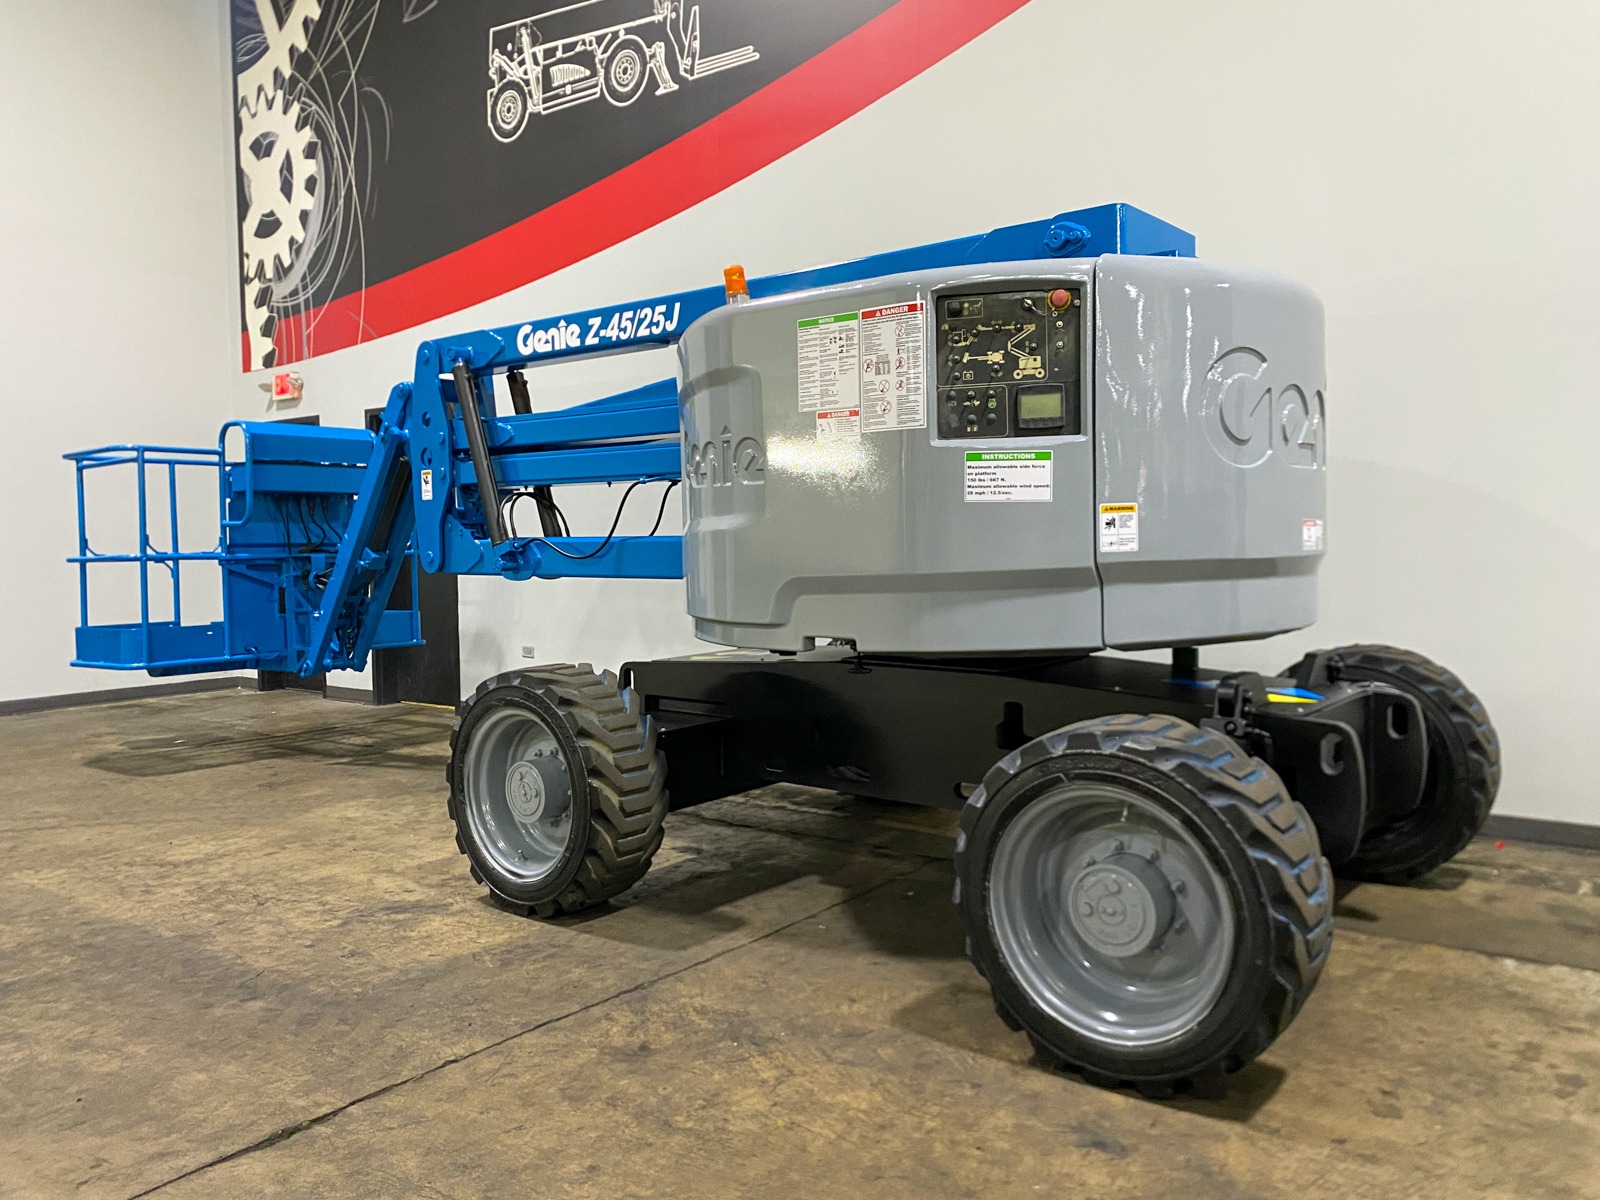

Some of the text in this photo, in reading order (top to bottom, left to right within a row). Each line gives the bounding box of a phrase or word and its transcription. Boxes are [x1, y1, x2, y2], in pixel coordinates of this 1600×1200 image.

[881, 305, 909, 316] DANGER
[516, 302, 681, 356] Genie Z-45/25J
[831, 410, 850, 418] DANGER
[685, 425, 765, 488] enie
